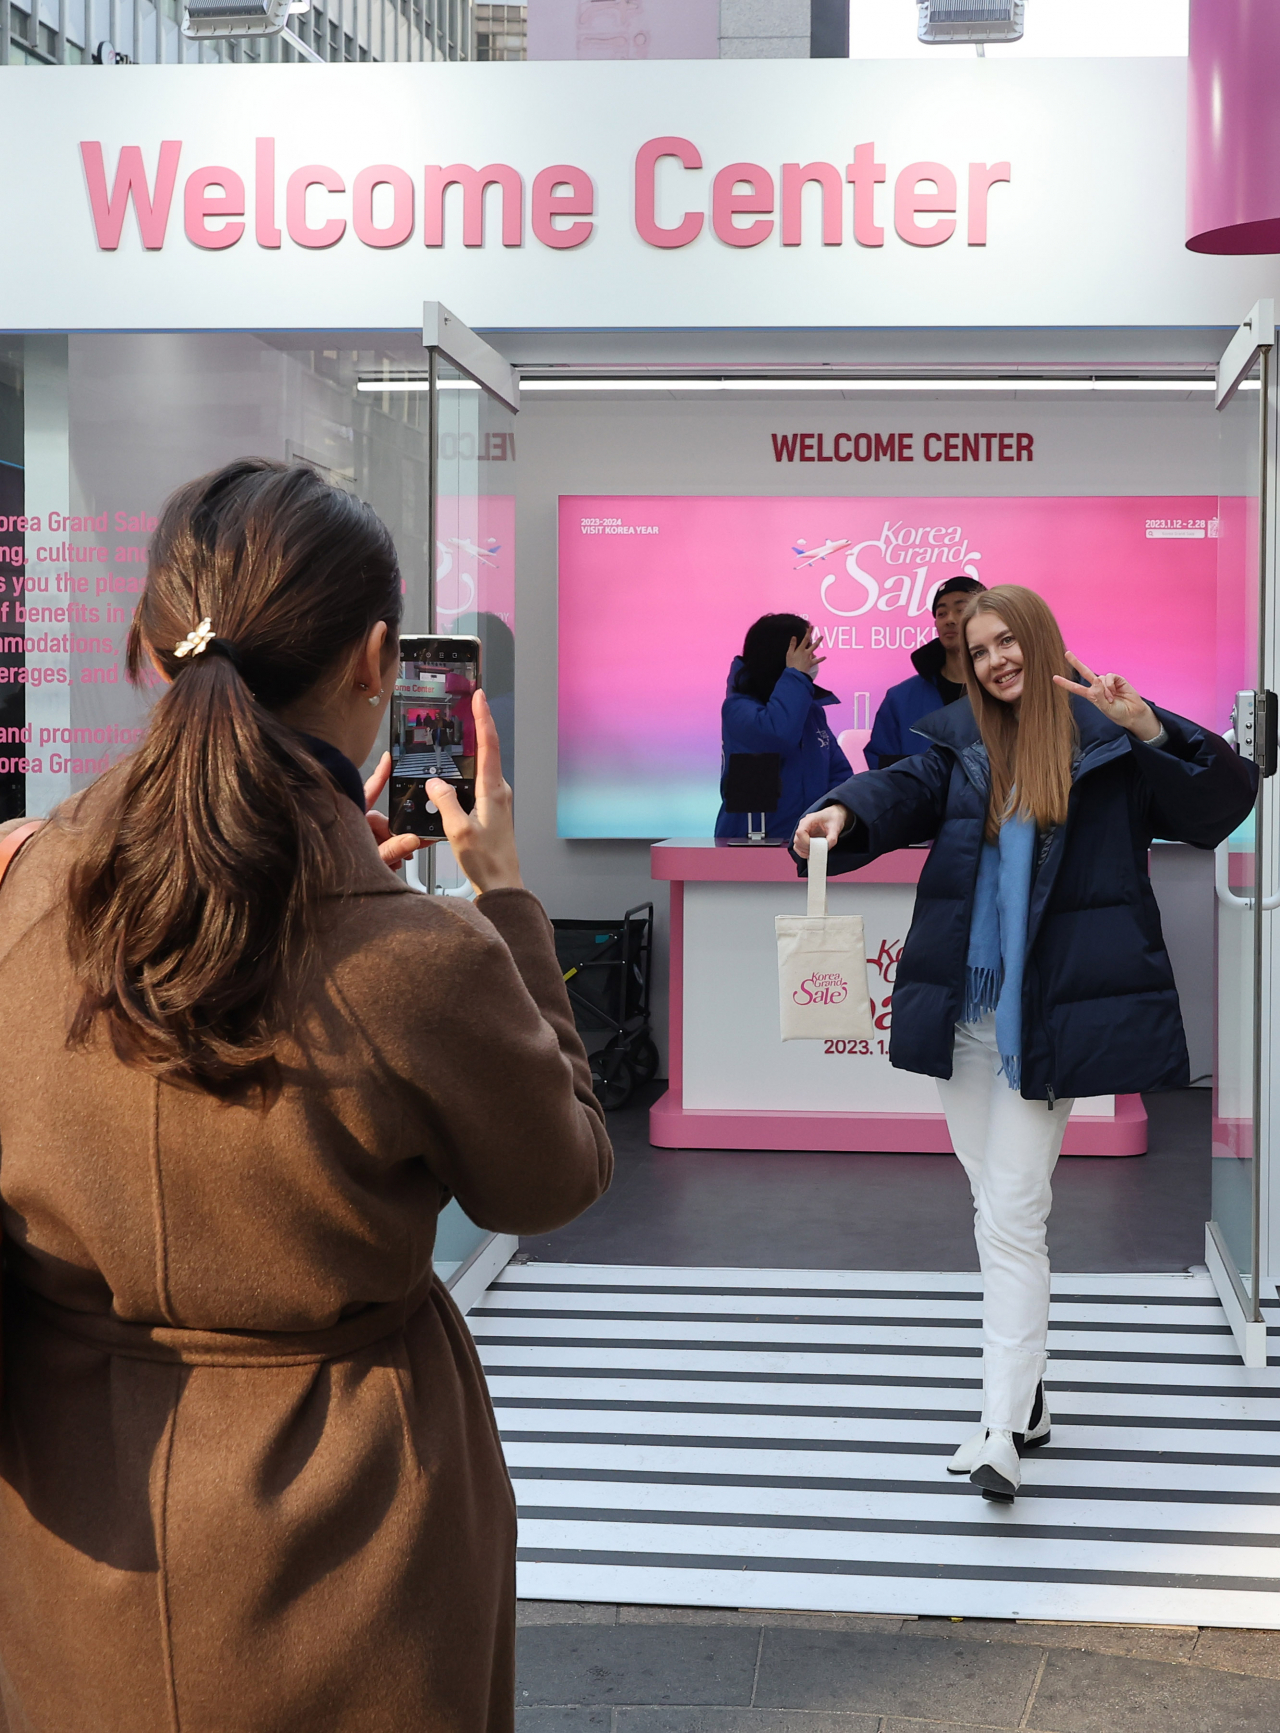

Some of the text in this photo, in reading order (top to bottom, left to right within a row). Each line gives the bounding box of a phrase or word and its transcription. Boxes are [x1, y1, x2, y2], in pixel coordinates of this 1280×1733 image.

[79, 136, 1011, 251] Welcome Center
[771, 433, 1034, 462] WELCOME CENTER
[0, 511, 159, 532] orea Grand Sale
[581, 518, 622, 526] 2023-2024
[581, 526, 659, 534] VISIT KOREA YEAR
[1187, 519, 1206, 528] 2.28
[879, 520, 963, 546] Korea
[37, 541, 108, 562] culture
[885, 540, 969, 568] Grand
[12, 576, 49, 597] you
[56, 572, 89, 593] the
[15, 601, 100, 623] benefits
[107, 602, 125, 623] in
[0, 632, 119, 656] modations,
[80, 662, 118, 684] and
[0, 757, 42, 773] orea
[50, 753, 110, 774] Grand
[811, 972, 840, 981] Korea
[814, 978, 843, 988] Grand
[793, 979, 848, 1005] Sale
[824, 1039, 873, 1055] 2023.
